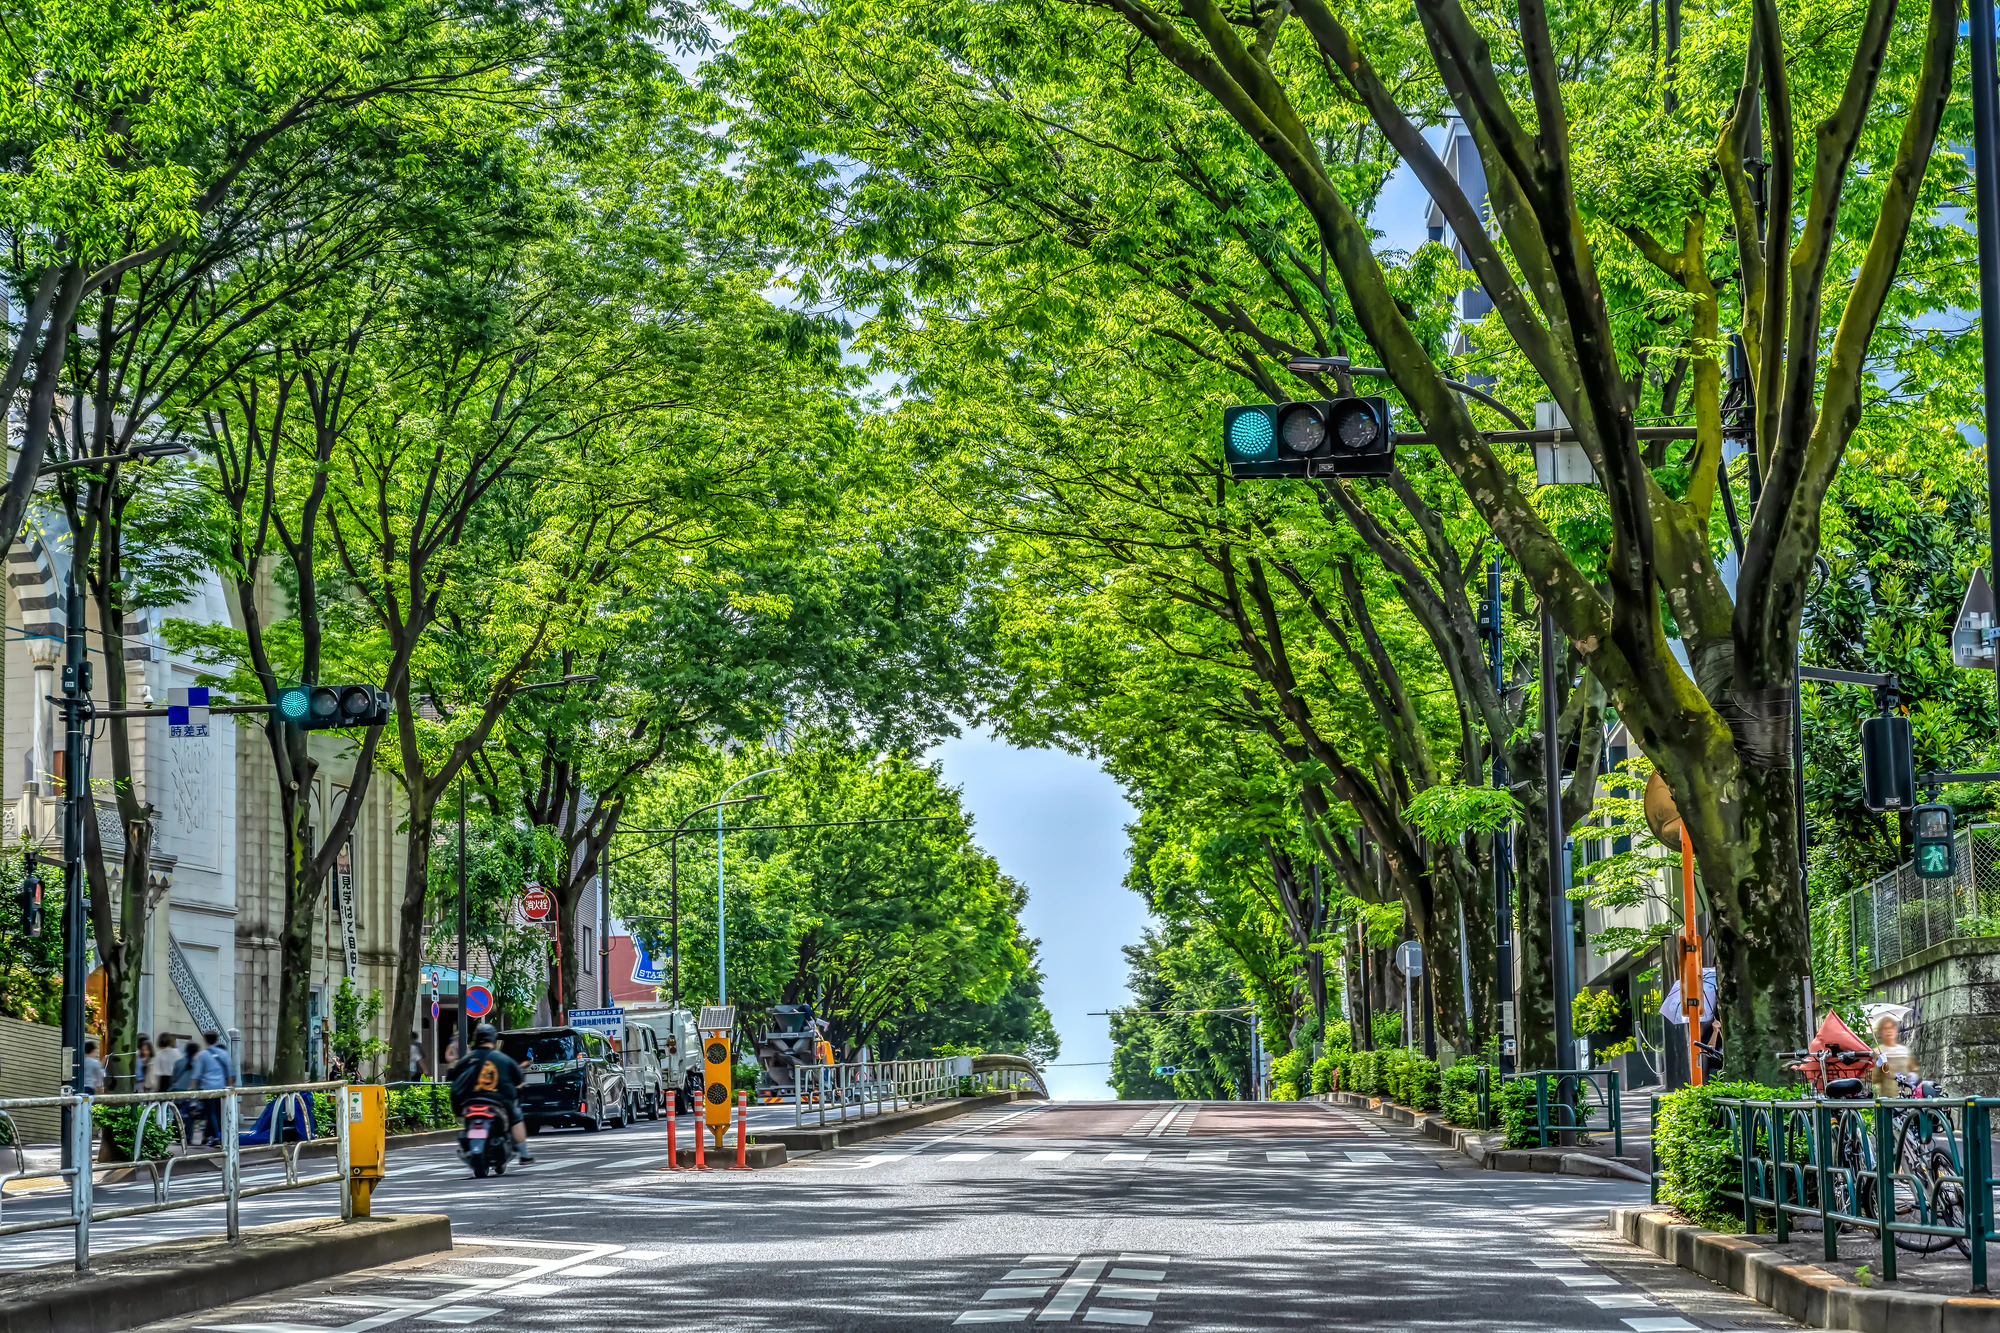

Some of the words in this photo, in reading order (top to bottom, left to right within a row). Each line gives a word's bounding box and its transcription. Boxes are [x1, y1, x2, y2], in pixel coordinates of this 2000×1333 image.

[171, 725, 207, 737] 時差式
[525, 899, 548, 911] 消火栓
